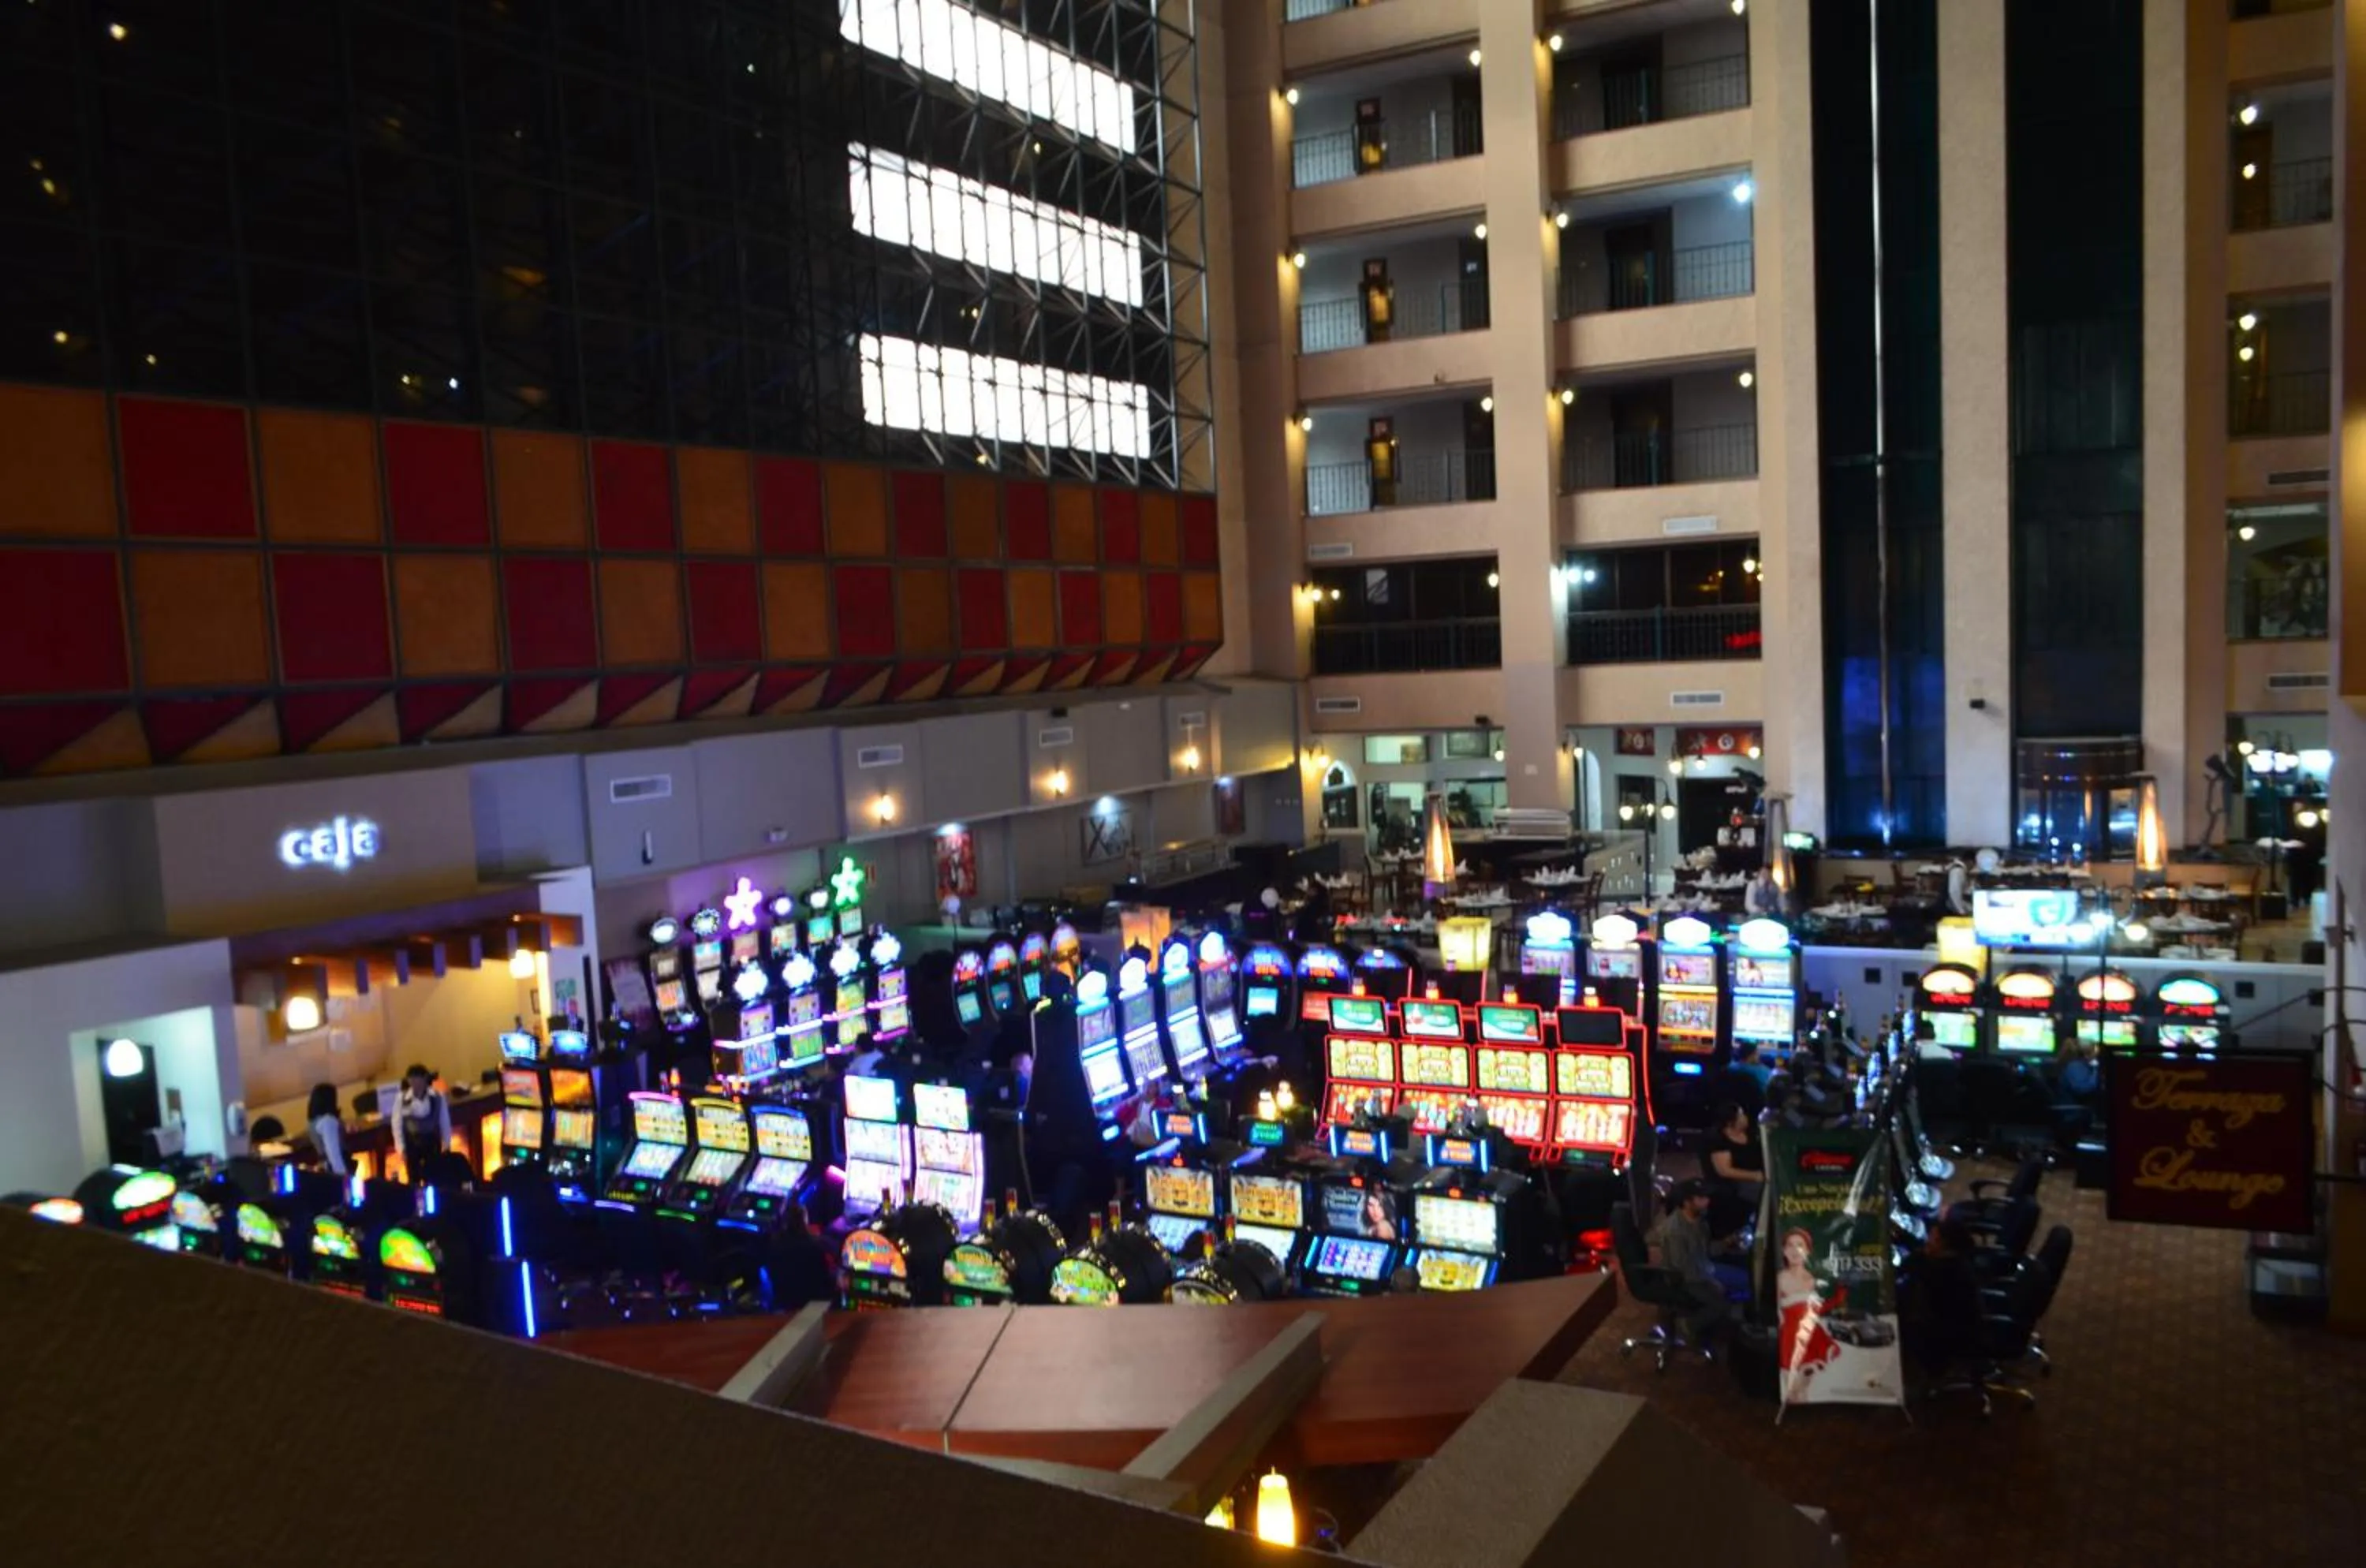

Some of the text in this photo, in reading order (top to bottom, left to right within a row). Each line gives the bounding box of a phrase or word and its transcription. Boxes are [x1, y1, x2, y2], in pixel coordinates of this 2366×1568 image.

[280, 816, 379, 873] caja
[2186, 1118, 2218, 1148] &
[2132, 1146, 2285, 1210] Lounge
